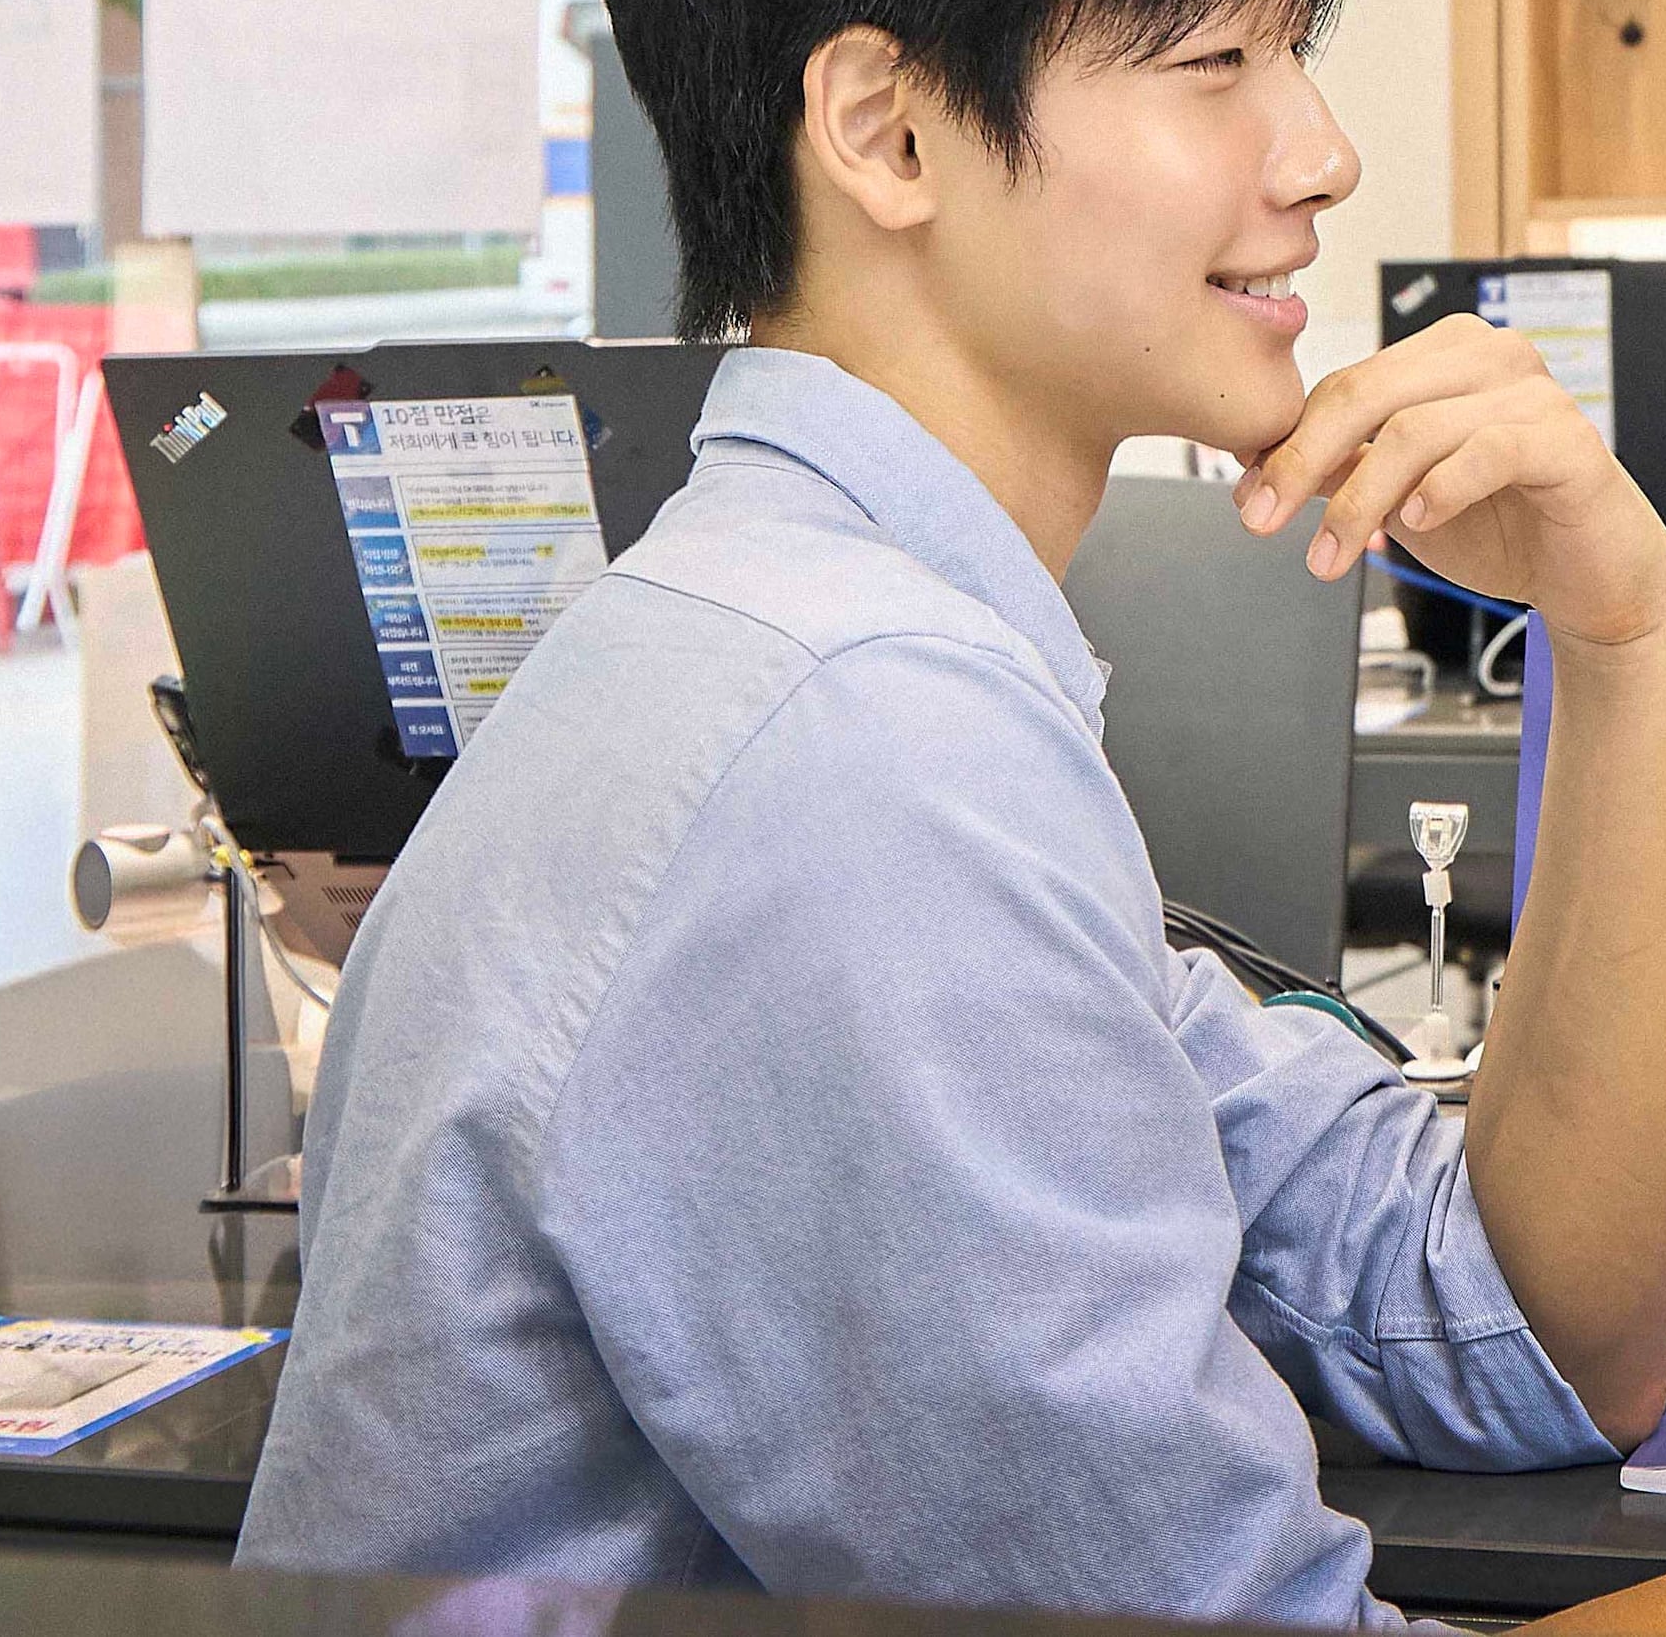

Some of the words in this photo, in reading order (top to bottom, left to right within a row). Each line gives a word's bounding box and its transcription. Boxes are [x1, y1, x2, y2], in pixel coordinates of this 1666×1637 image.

[383, 406, 429, 427] 10점
[434, 404, 492, 426] 만점은
[149, 392, 228, 463] ThinkPad
[390, 430, 457, 451] 저희에게
[461, 431, 478, 449] 큰
[484, 431, 515, 448] 힘이
[522, 429, 579, 449] 됩니다.
